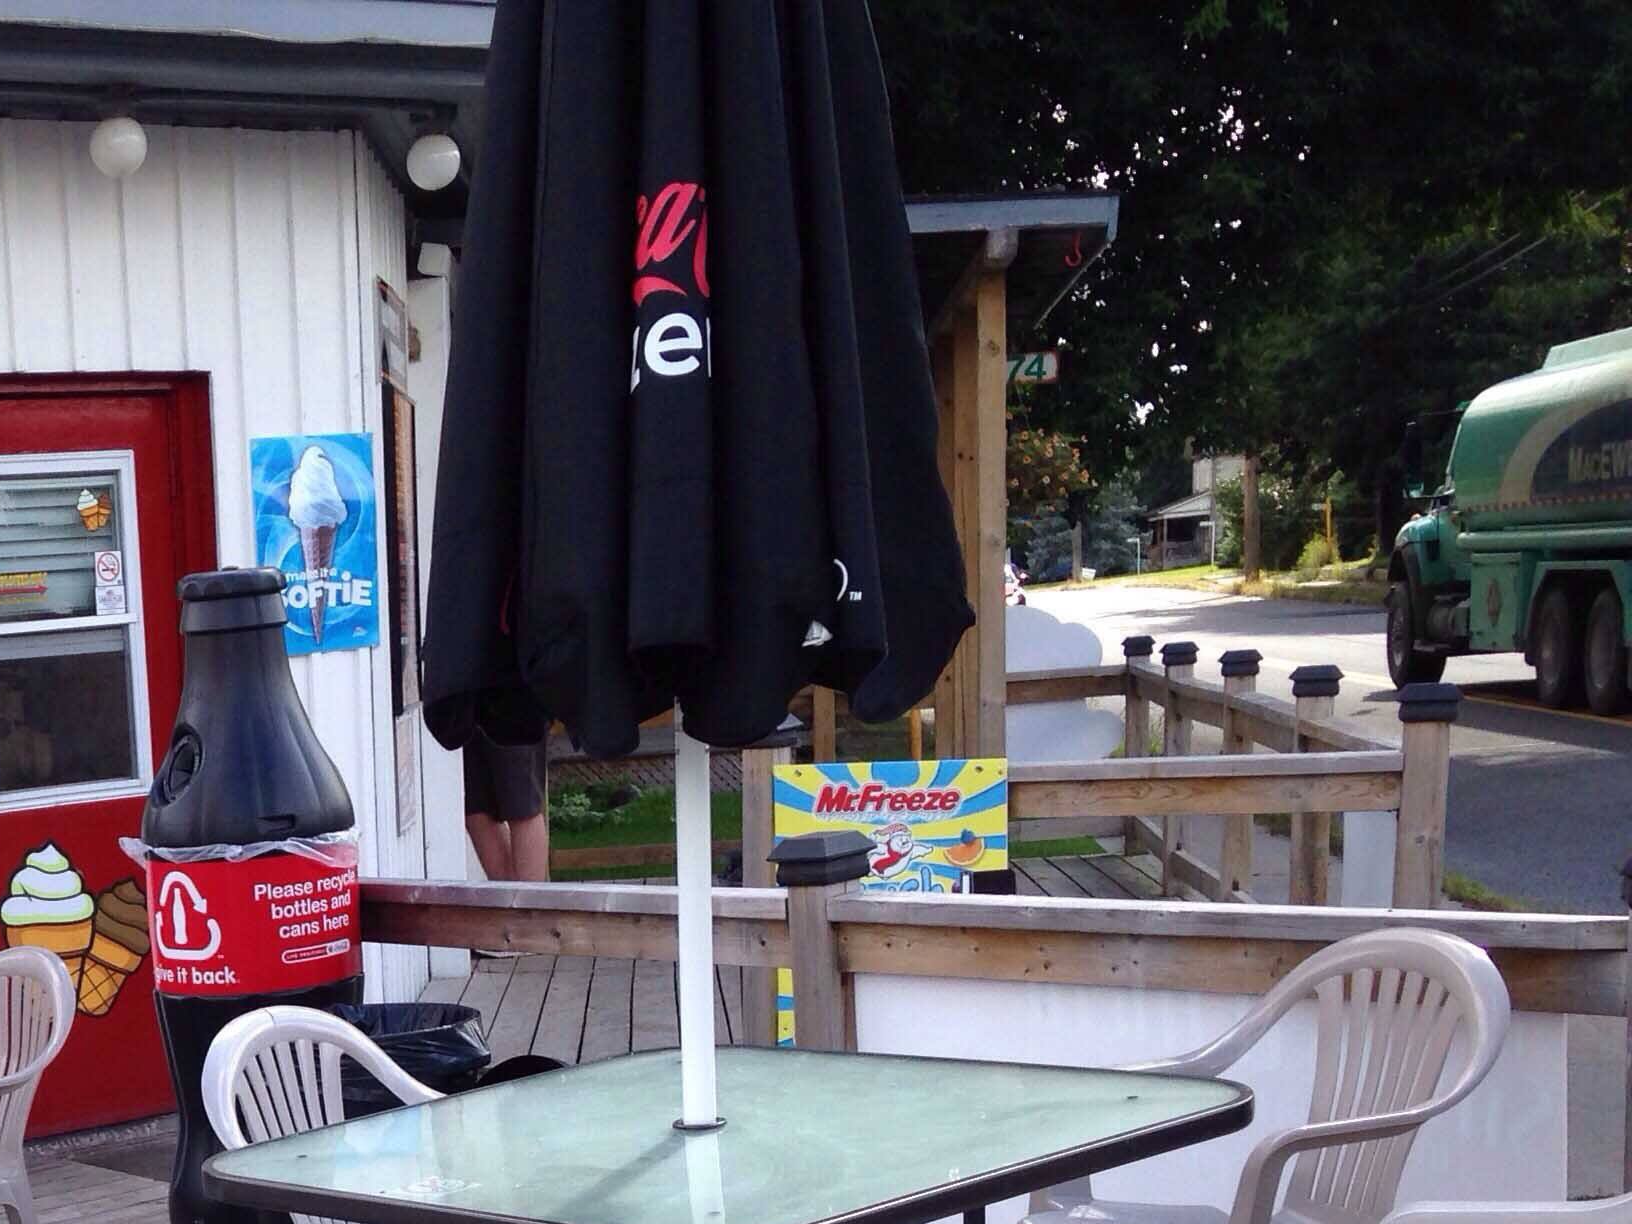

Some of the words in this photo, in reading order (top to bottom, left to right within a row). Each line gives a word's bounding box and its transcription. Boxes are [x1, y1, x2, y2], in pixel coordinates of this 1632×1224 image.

[254, 881, 313, 901] Please
[271, 898, 328, 920] bottles
[331, 890, 351, 910] and
[279, 921, 320, 939] cans
[323, 914, 349, 932] here
[177, 966, 188, 984] it
[192, 966, 236, 985] back
